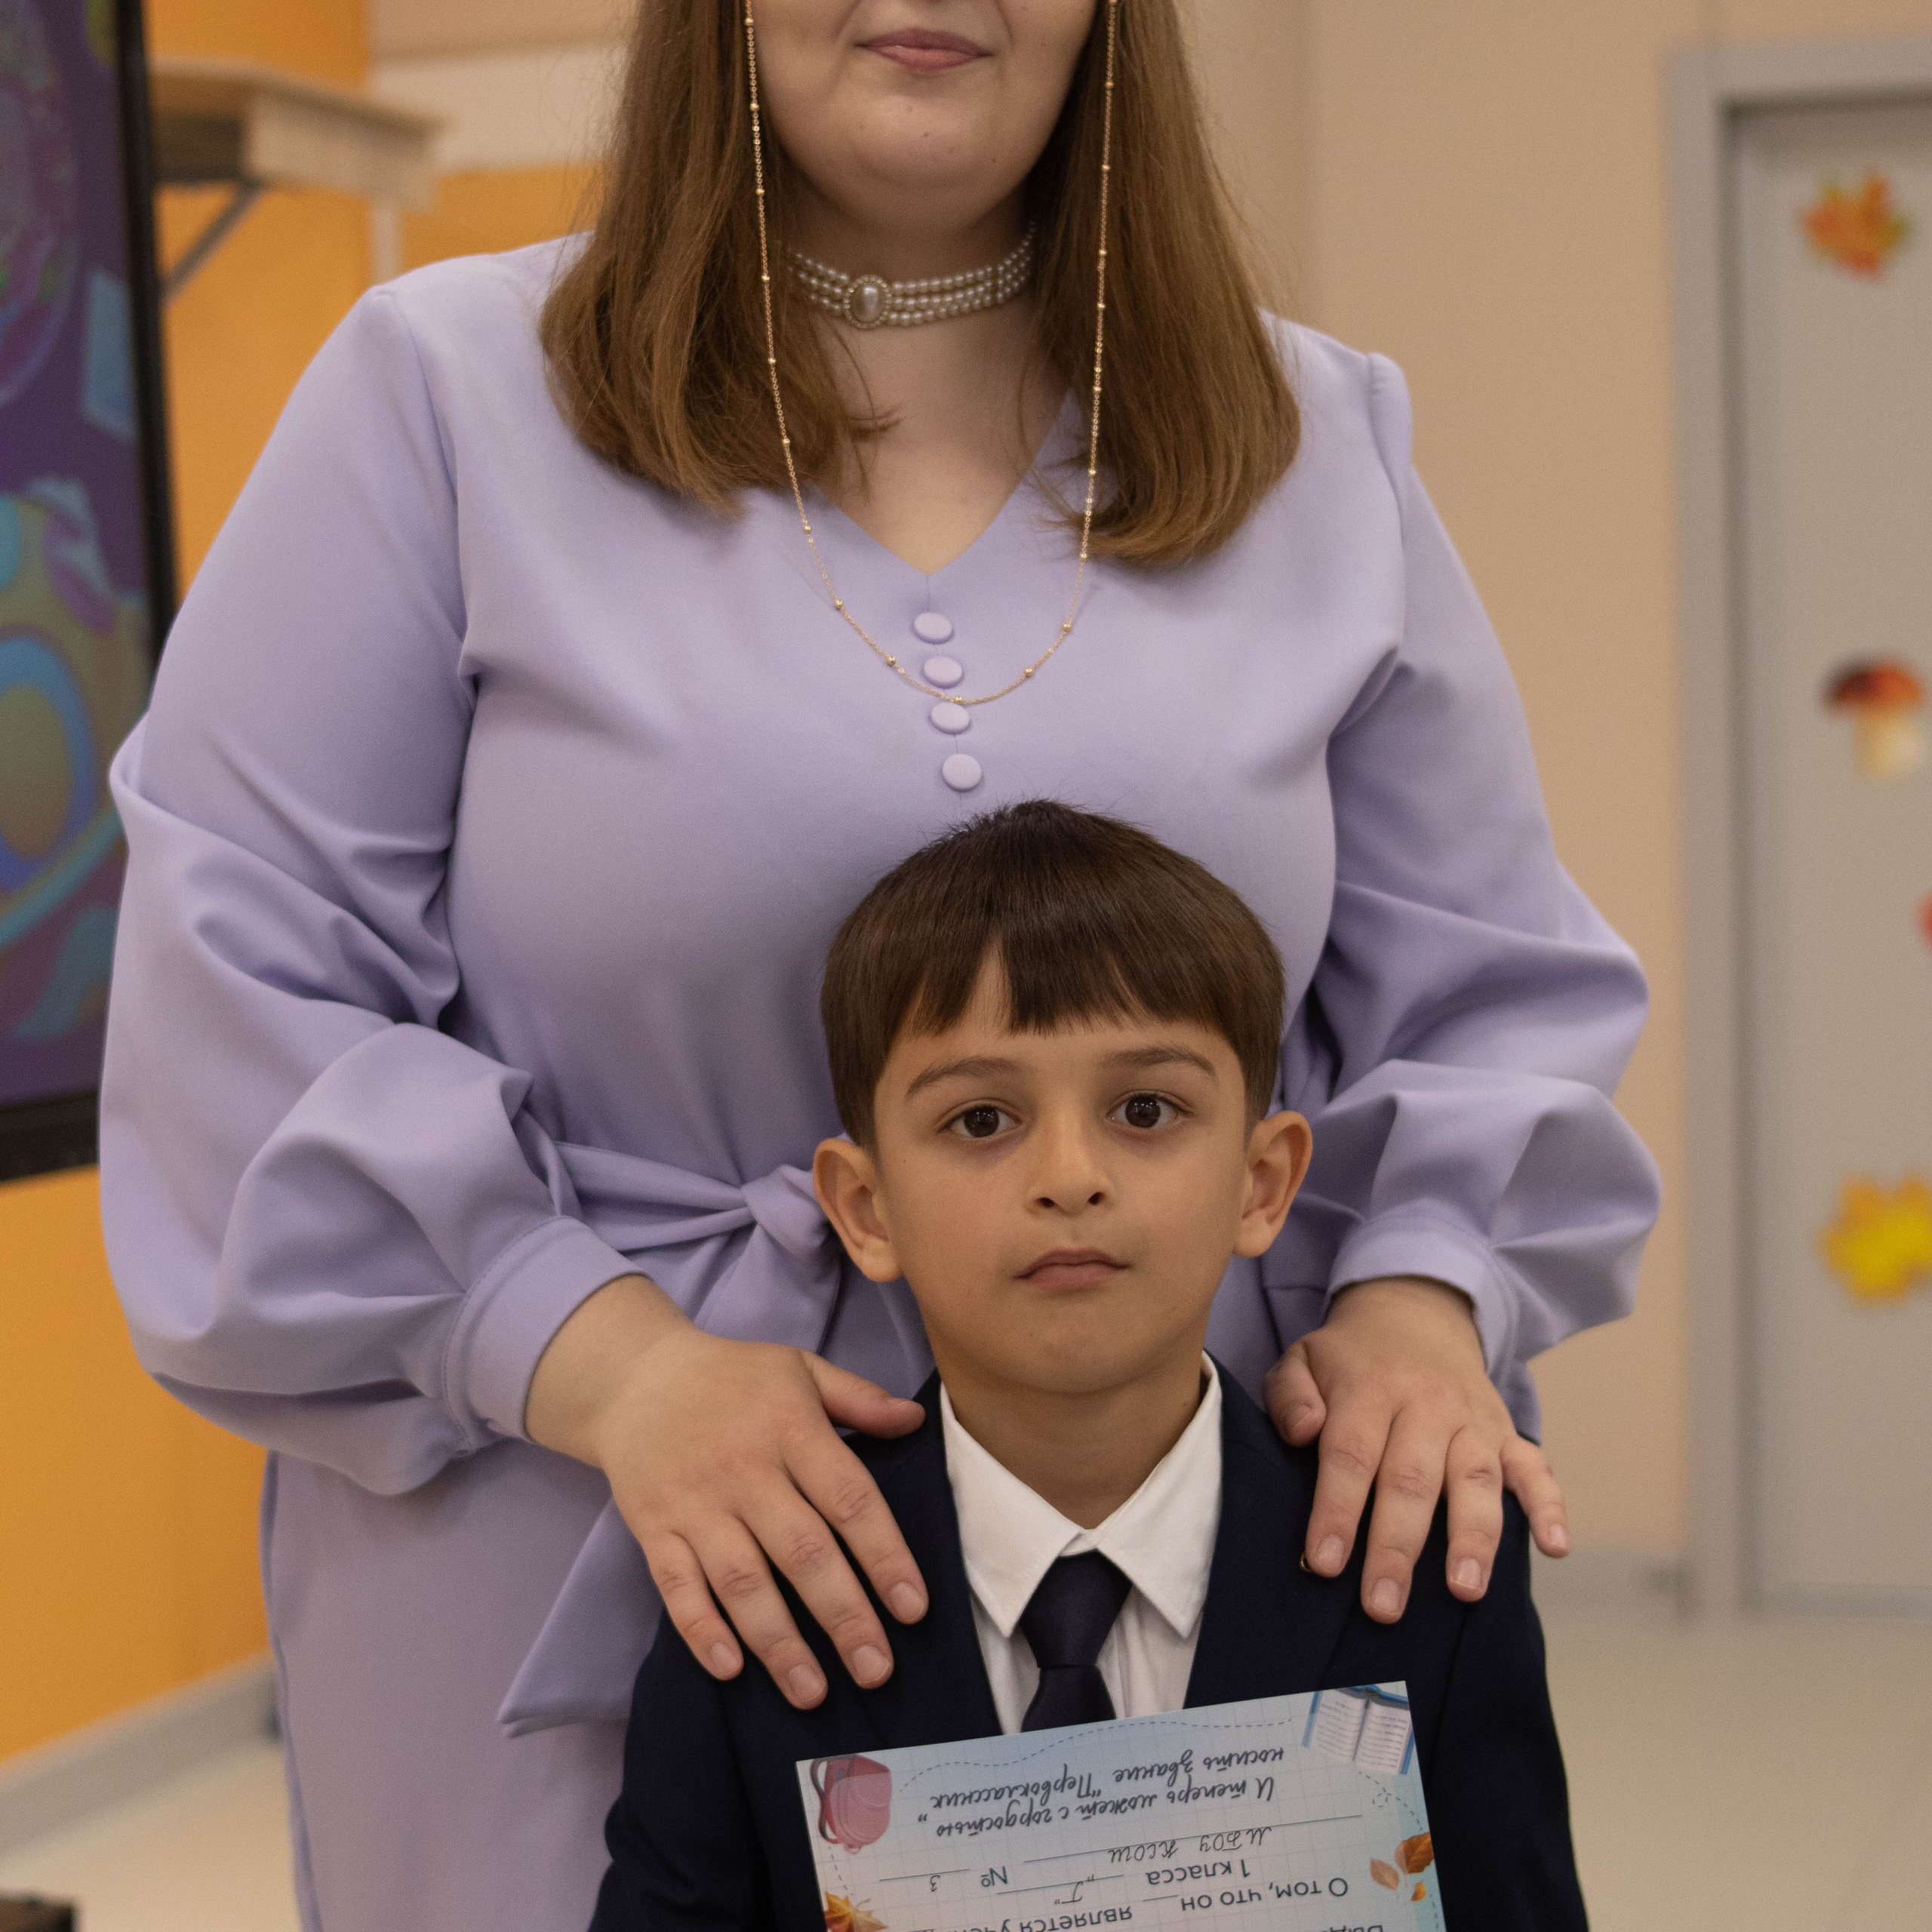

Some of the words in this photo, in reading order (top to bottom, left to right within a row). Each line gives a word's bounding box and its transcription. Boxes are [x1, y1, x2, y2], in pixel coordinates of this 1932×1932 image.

[1112, 1749, 1194, 1788] звание
[1202, 1747, 1284, 1773] носить
[1165, 1774, 1247, 1804] теперь
[1255, 1776, 1275, 1802] И
[936, 1794, 1053, 1838] гордостью
[1057, 1806, 1070, 1820] с
[1075, 1793, 1158, 1821] может
[980, 1865, 1009, 1888] №
[1144, 1860, 1232, 1886] класса
[1240, 1858, 1251, 1878] 1
[929, 1874, 941, 1893] 3
[1268, 1880, 1323, 1900] том,
[1327, 1877, 1349, 1898] О
[1180, 1894, 1213, 1912] он
[1219, 1888, 1263, 1906] что
[1019, 1906, 1133, 1932] является
